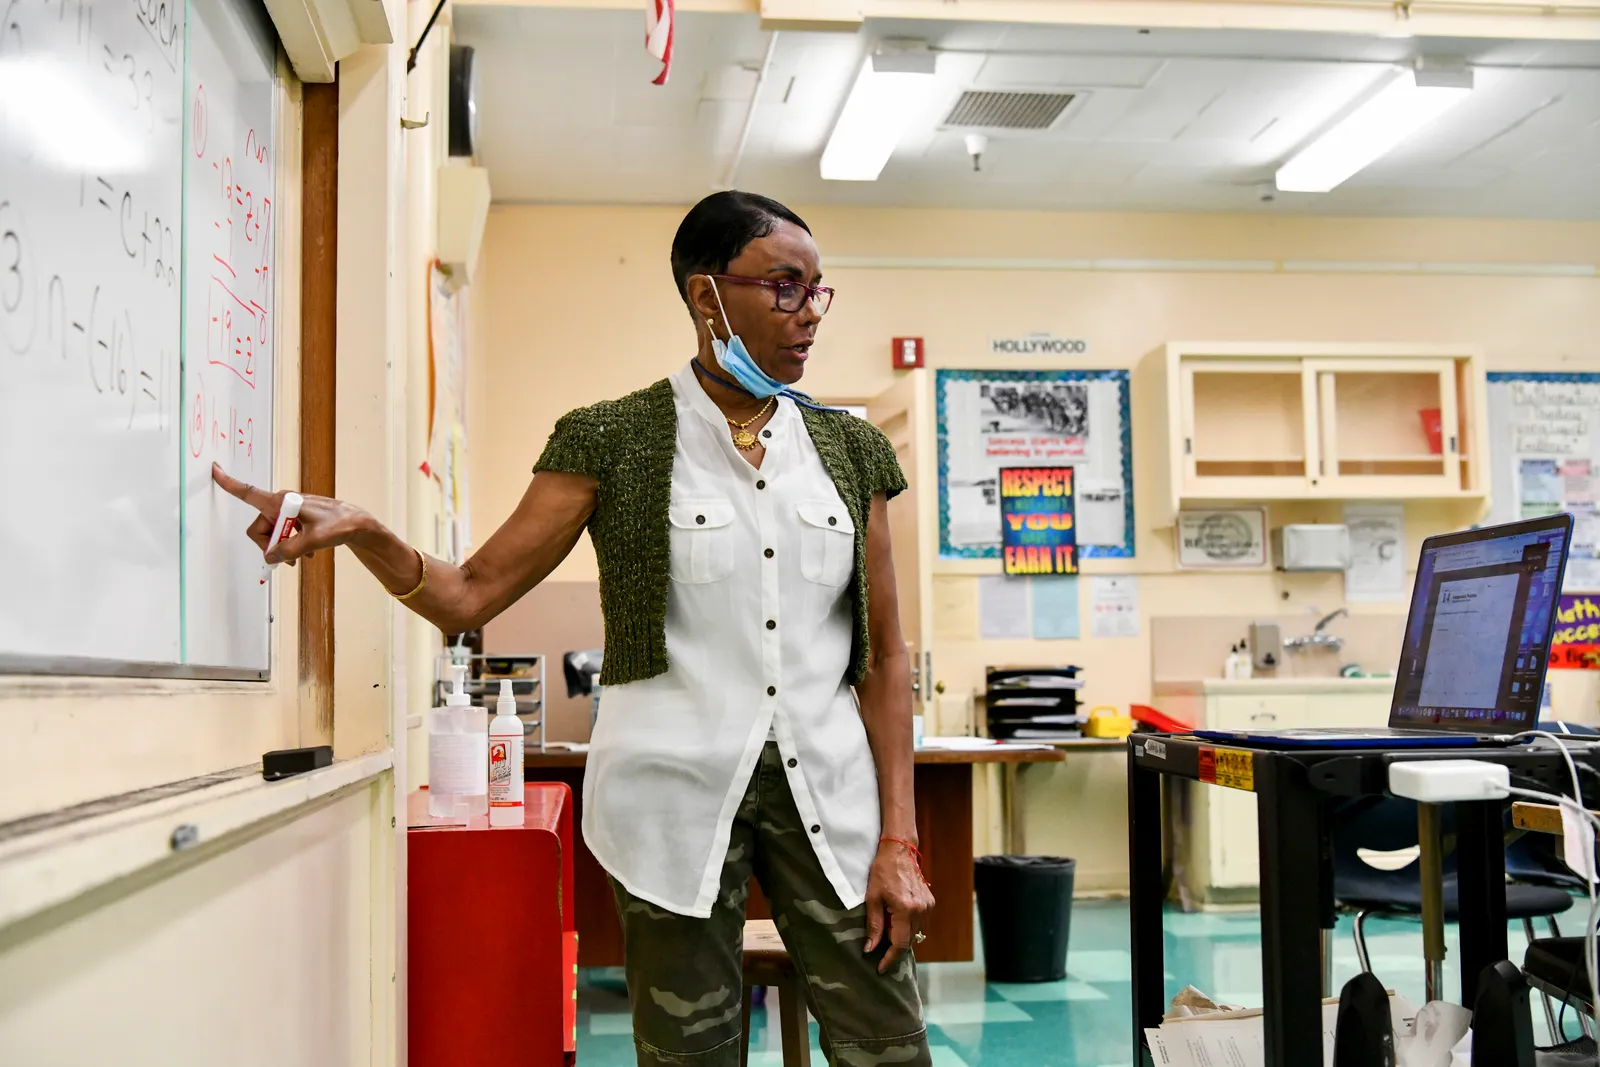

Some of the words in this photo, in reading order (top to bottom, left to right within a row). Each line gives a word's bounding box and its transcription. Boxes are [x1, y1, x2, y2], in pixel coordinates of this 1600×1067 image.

[993, 339, 1087, 353] HOLLYWOOD
[1001, 468, 1073, 497] RESPECT
[1005, 512, 1073, 530] YOU
[1004, 545, 1053, 574] EARN
[1055, 545, 1078, 573] IT.
